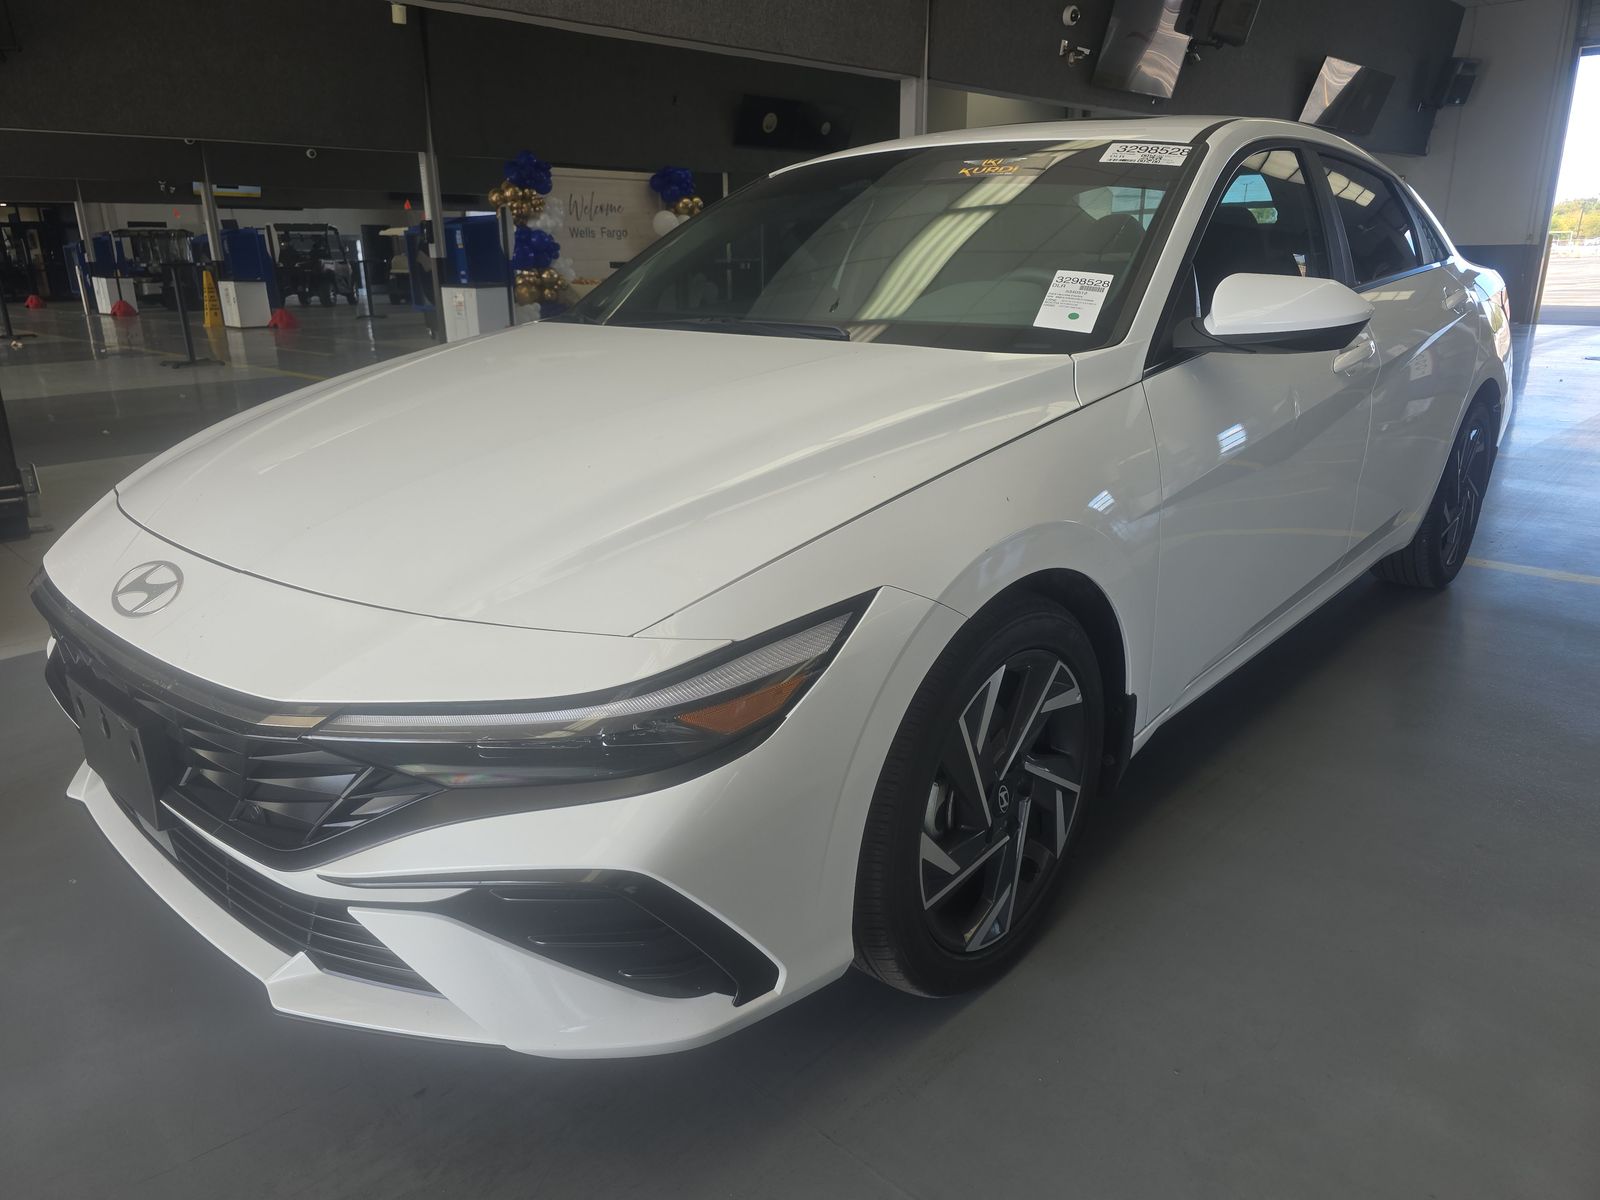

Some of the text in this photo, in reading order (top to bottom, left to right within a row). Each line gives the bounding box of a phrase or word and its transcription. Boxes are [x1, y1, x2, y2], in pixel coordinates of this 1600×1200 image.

[1116, 144, 1191, 156] 3298528
[568, 191, 624, 221] Welcome
[568, 227, 628, 240] Wells Fargo
[1055, 275, 1110, 288] 3298528
